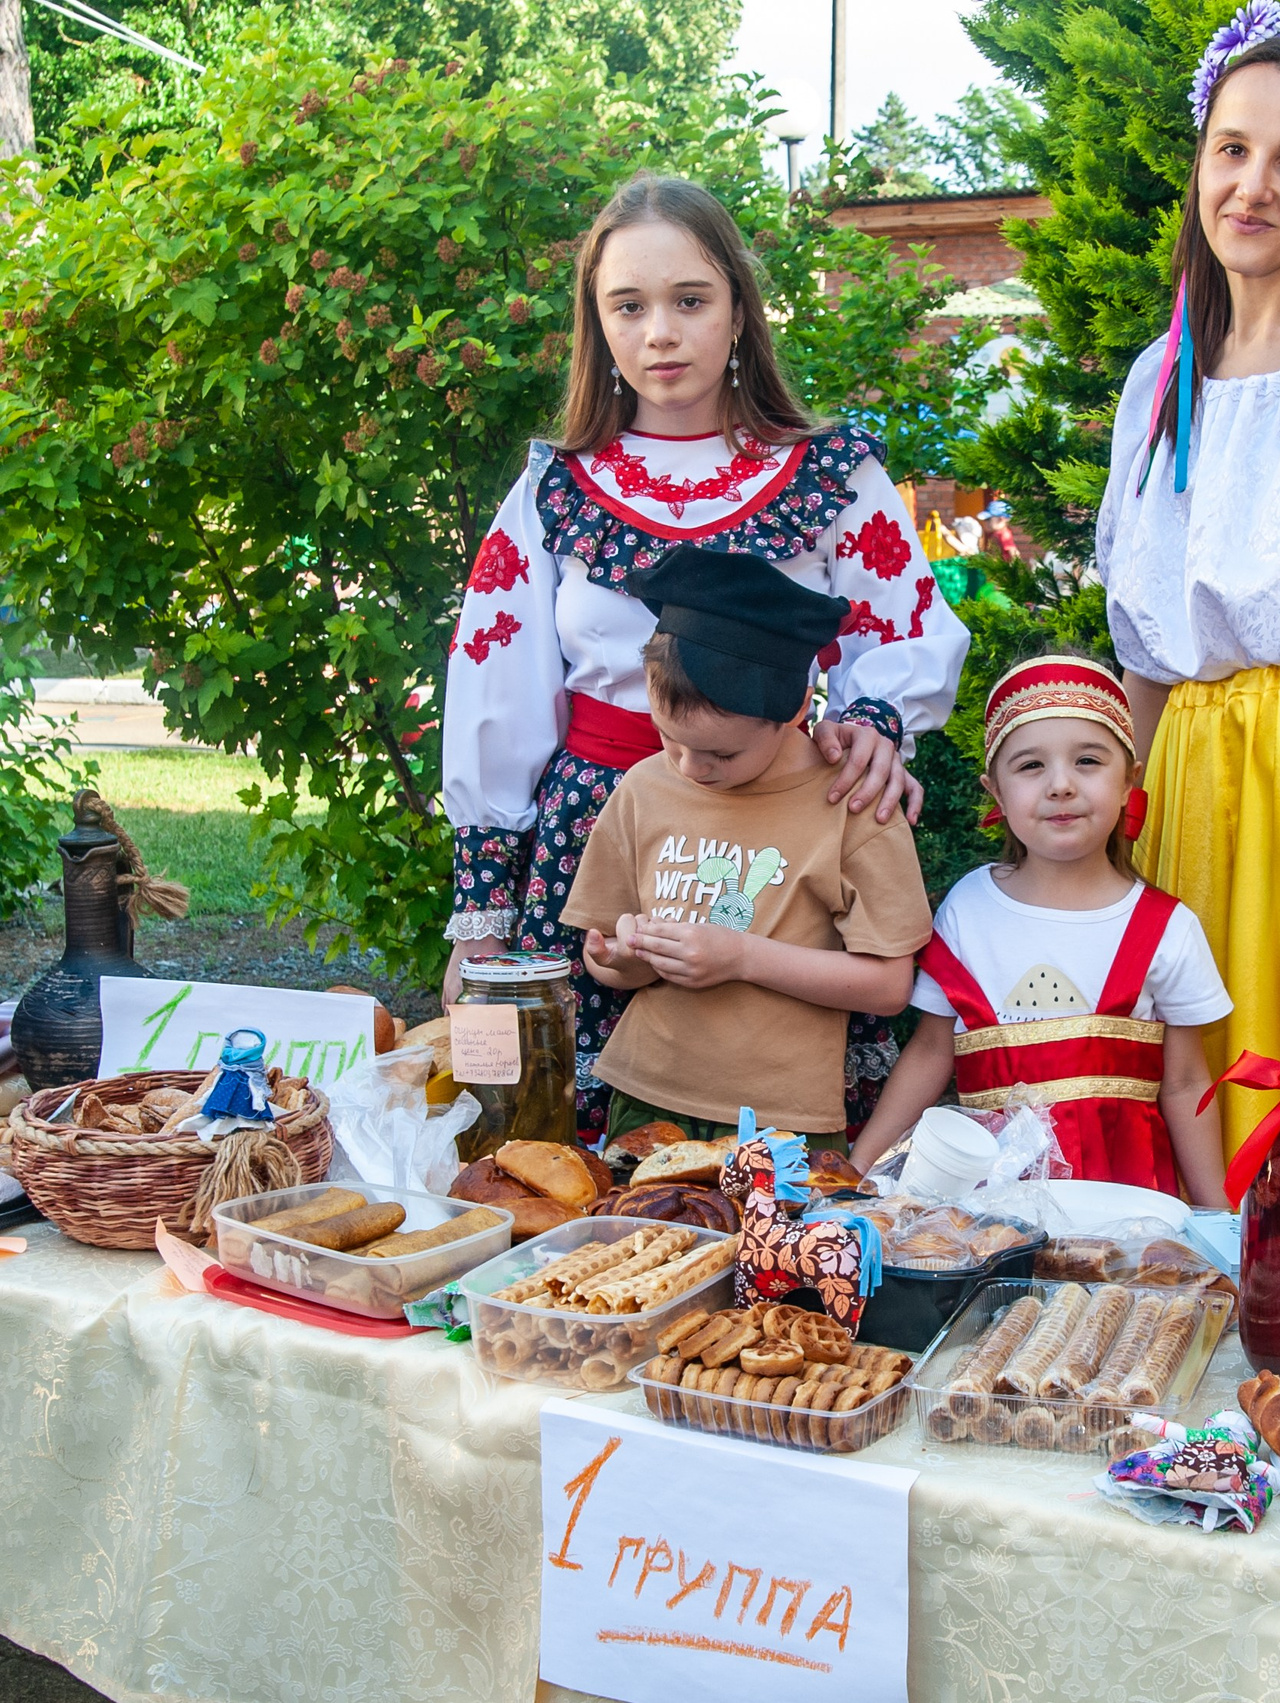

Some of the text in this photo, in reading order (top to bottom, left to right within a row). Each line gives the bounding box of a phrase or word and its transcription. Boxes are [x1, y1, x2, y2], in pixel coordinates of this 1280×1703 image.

[654, 870, 723, 907] WITH
[117, 984, 193, 1073] 1
[548, 1435, 855, 1652] 1 ГРУППА
